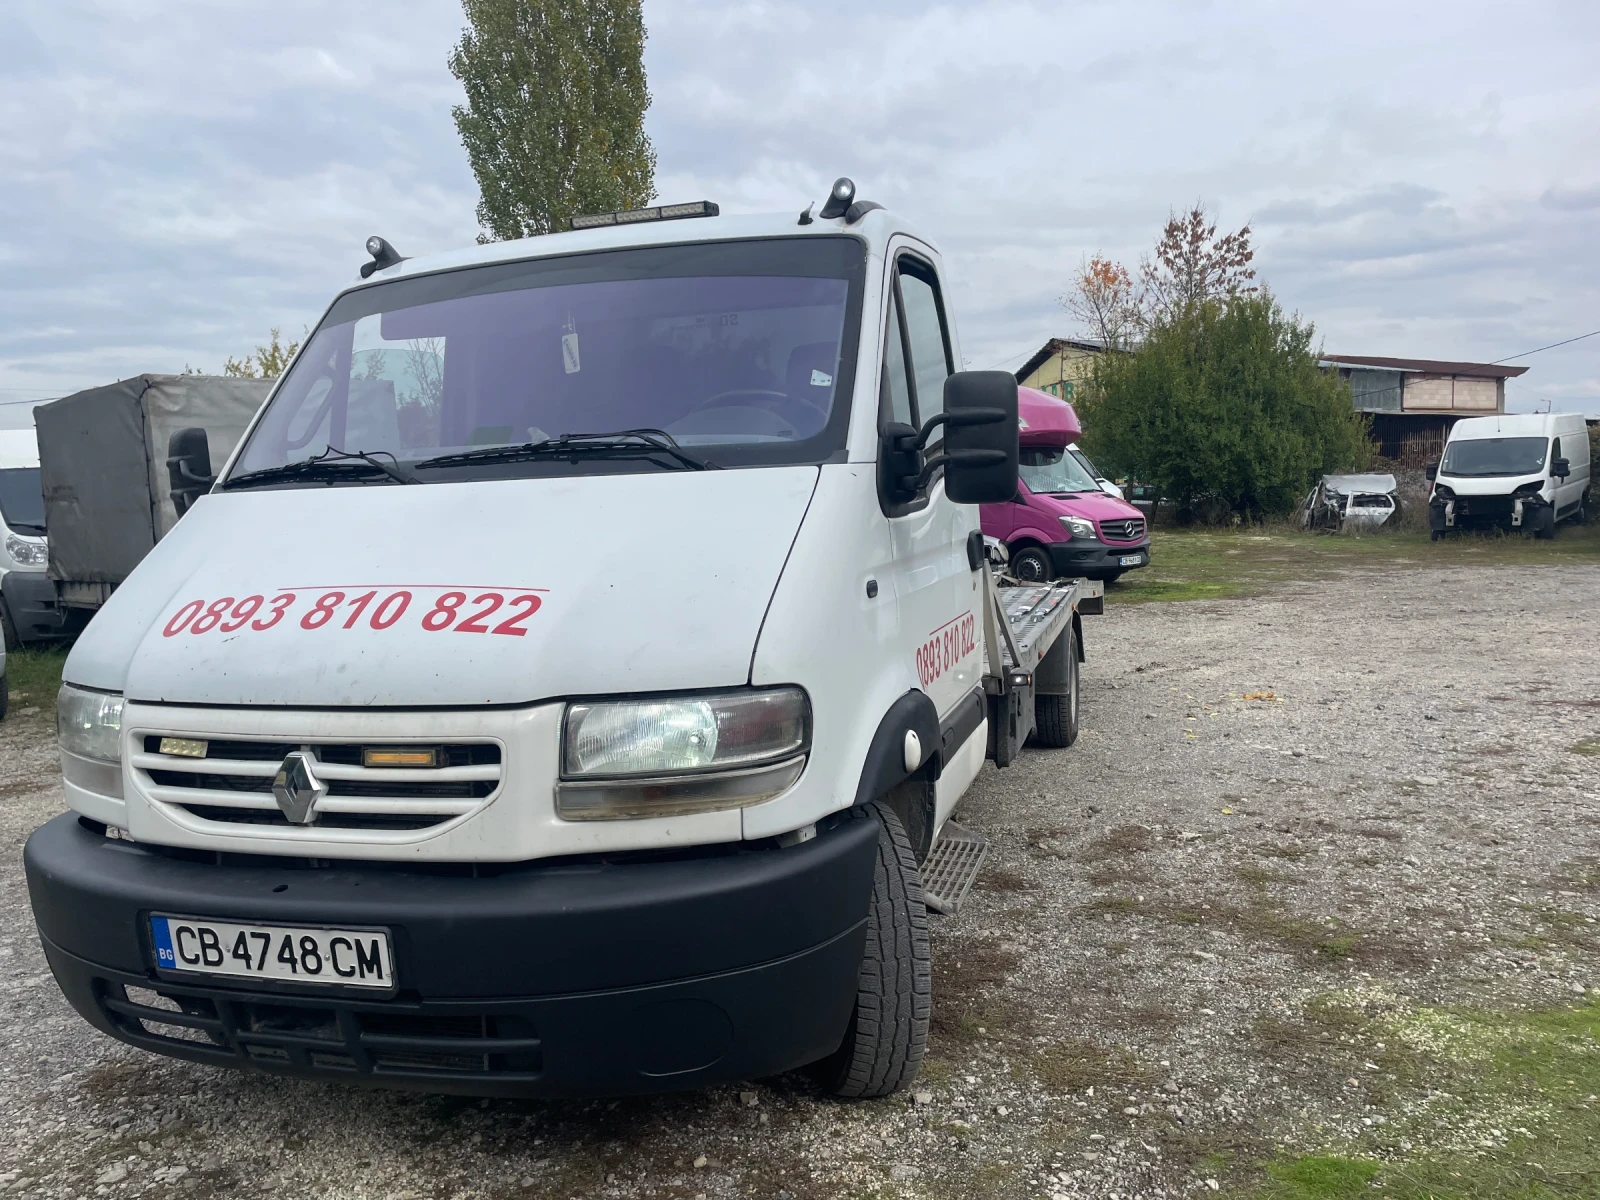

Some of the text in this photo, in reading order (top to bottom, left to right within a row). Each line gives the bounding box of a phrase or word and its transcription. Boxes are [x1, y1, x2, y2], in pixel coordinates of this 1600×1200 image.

[162, 591, 542, 638] 0893 810 822
[916, 614, 975, 692] 0893 810 822
[159, 948, 174, 961] BG
[232, 931, 323, 975] 4748
